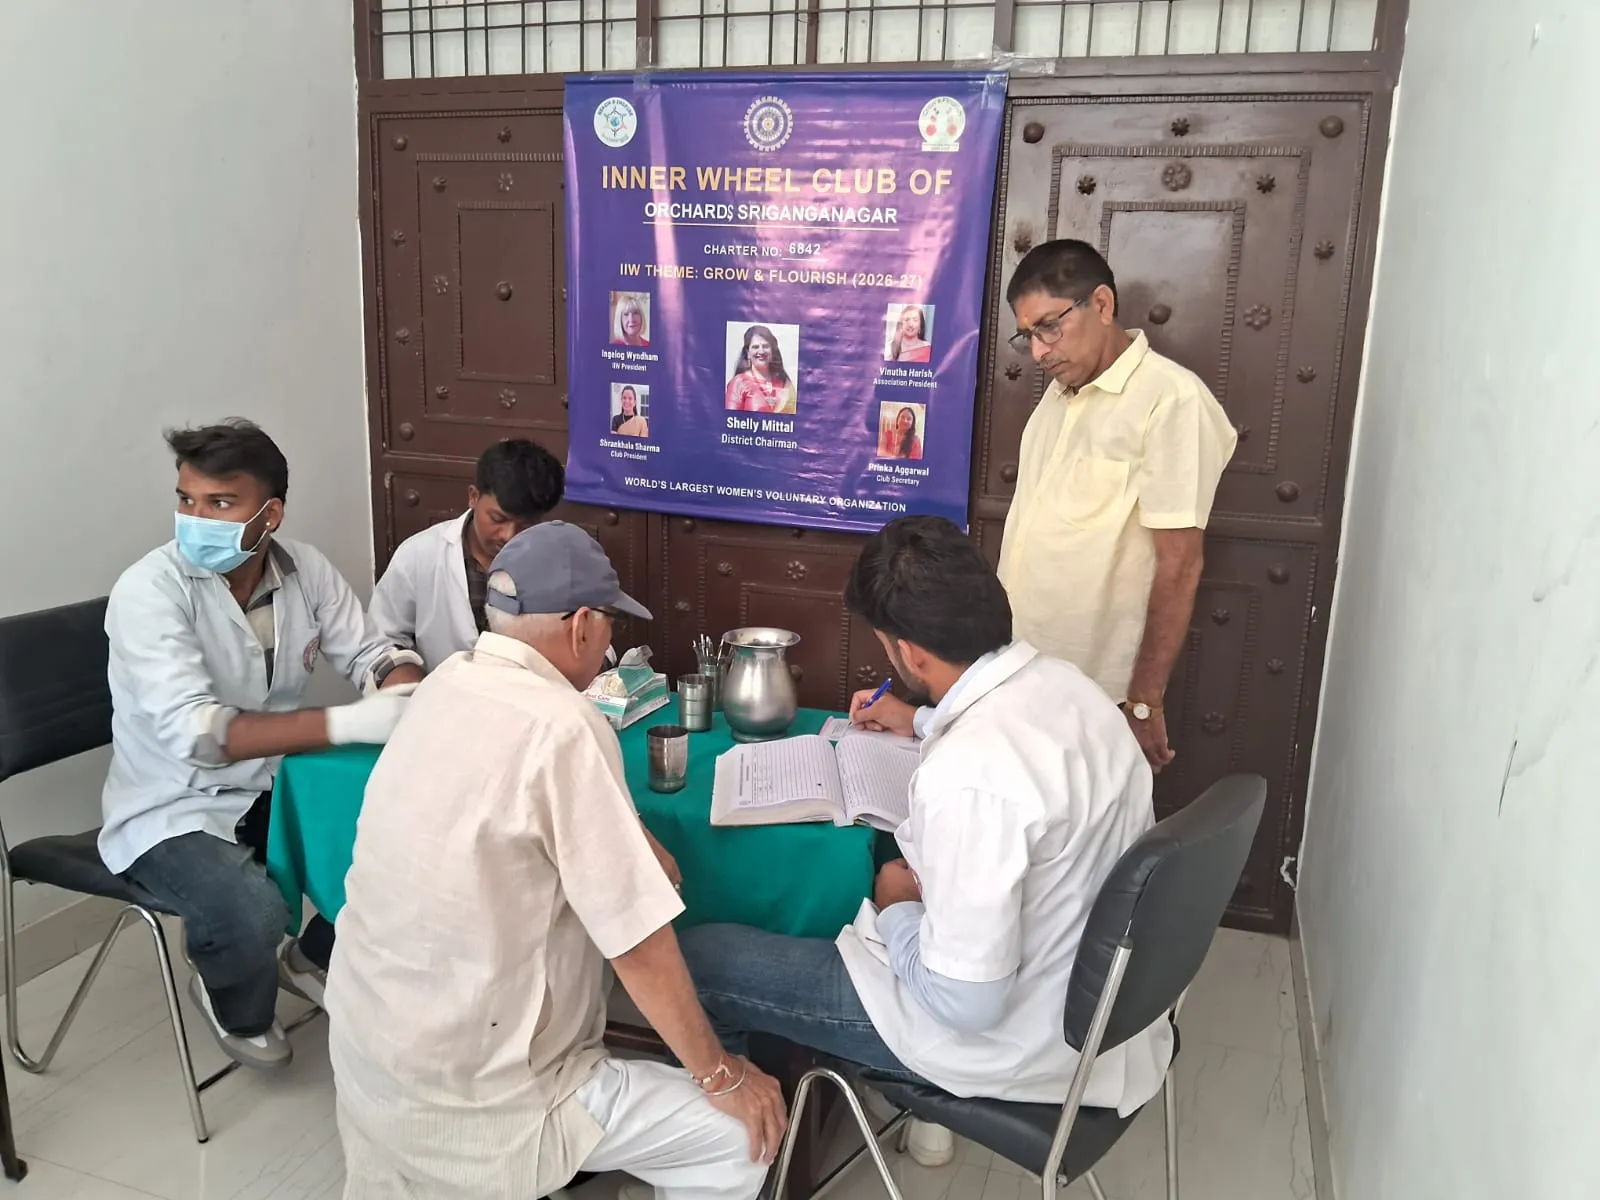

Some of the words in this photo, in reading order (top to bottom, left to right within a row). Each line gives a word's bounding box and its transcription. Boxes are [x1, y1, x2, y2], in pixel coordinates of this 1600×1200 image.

[602, 165, 687, 191] INNER
[696, 166, 801, 193] WHEEL
[812, 168, 897, 194] CLUB
[909, 169, 953, 195] OF
[737, 204, 898, 224] SRIGANGANAGAR
[704, 244, 758, 257] CHARTER
[789, 242, 821, 256] 6842
[620, 264, 641, 276] IIW
[645, 264, 698, 279] THEME:
[703, 267, 749, 281] GROW
[754, 269, 764, 282] &
[769, 269, 847, 285] FLOURISH
[852, 273, 923, 289] (2026-27)
[626, 351, 659, 362] Wyndham
[879, 366, 907, 377] Vinutha
[908, 368, 933, 378] Harish
[872, 377, 908, 387] Association
[908, 379, 938, 389] President
[726, 416, 759, 433] Shelly
[762, 419, 794, 433] Mittal
[634, 442, 661, 453] Sharma
[721, 433, 753, 446] District
[755, 436, 798, 449] Chairman
[610, 450, 623, 458] Club
[894, 465, 930, 477] Aggarwal
[876, 474, 890, 483] Club
[891, 475, 920, 487] Secretary
[624, 476, 667, 490] WORLD'S
[669, 482, 714, 494] LARGEST
[716, 486, 763, 499] WOMEN'S
[765, 491, 826, 505] VOLUNTARY
[829, 497, 907, 512] ORGANIZATION
